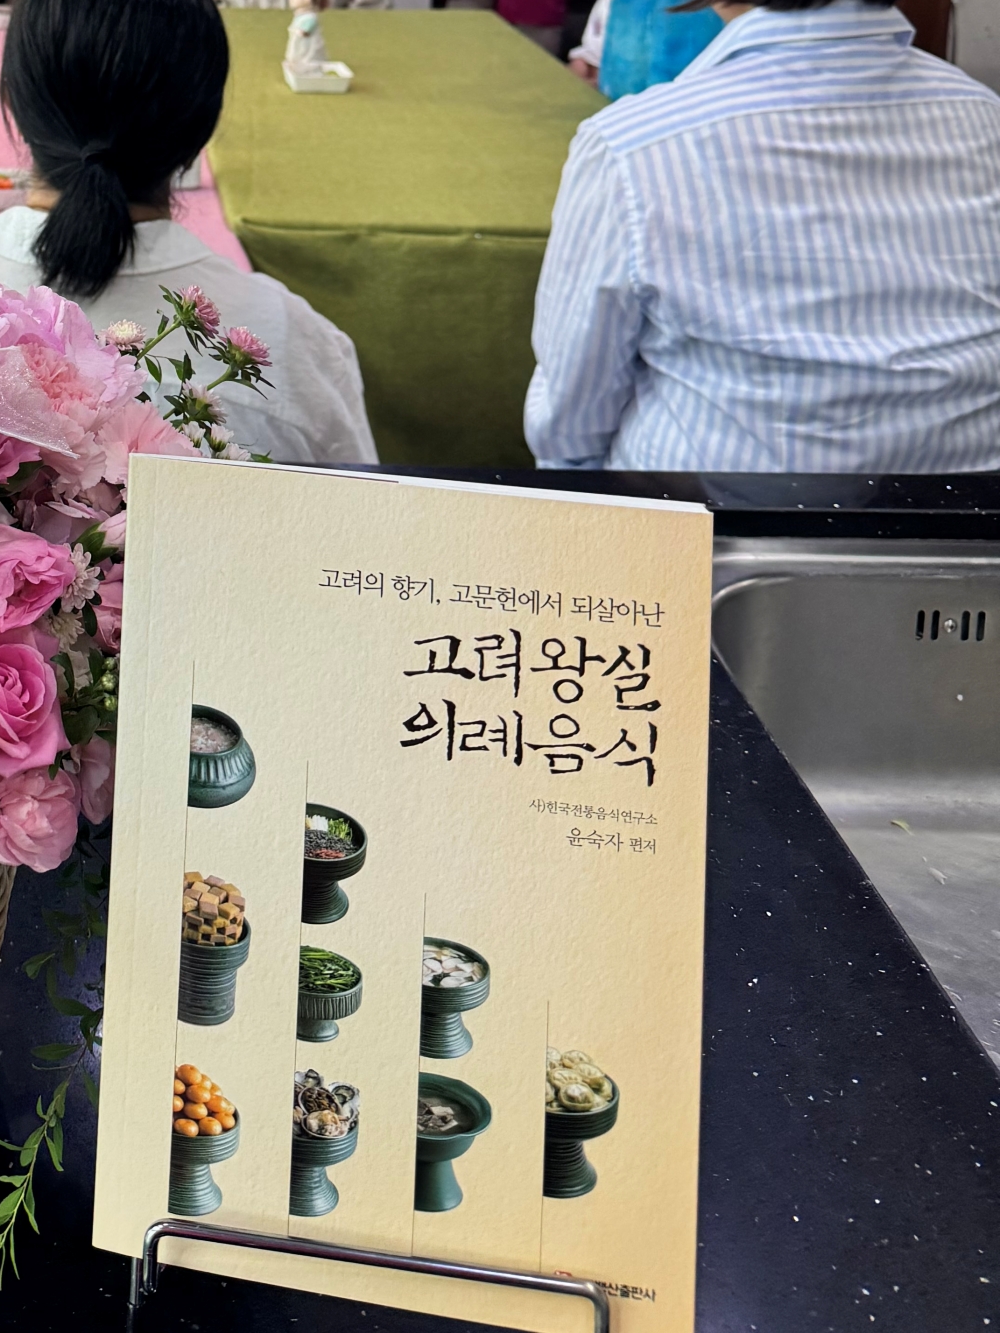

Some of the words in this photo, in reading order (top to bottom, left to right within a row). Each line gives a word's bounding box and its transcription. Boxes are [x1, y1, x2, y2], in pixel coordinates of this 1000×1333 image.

[318, 569, 384, 598] 고려의
[391, 574, 441, 606] 향기,
[449, 583, 562, 618] 고문헌에서
[570, 595, 666, 628] 되살아난
[565, 827, 625, 853] 윤숙자
[629, 836, 657, 855] 편저
